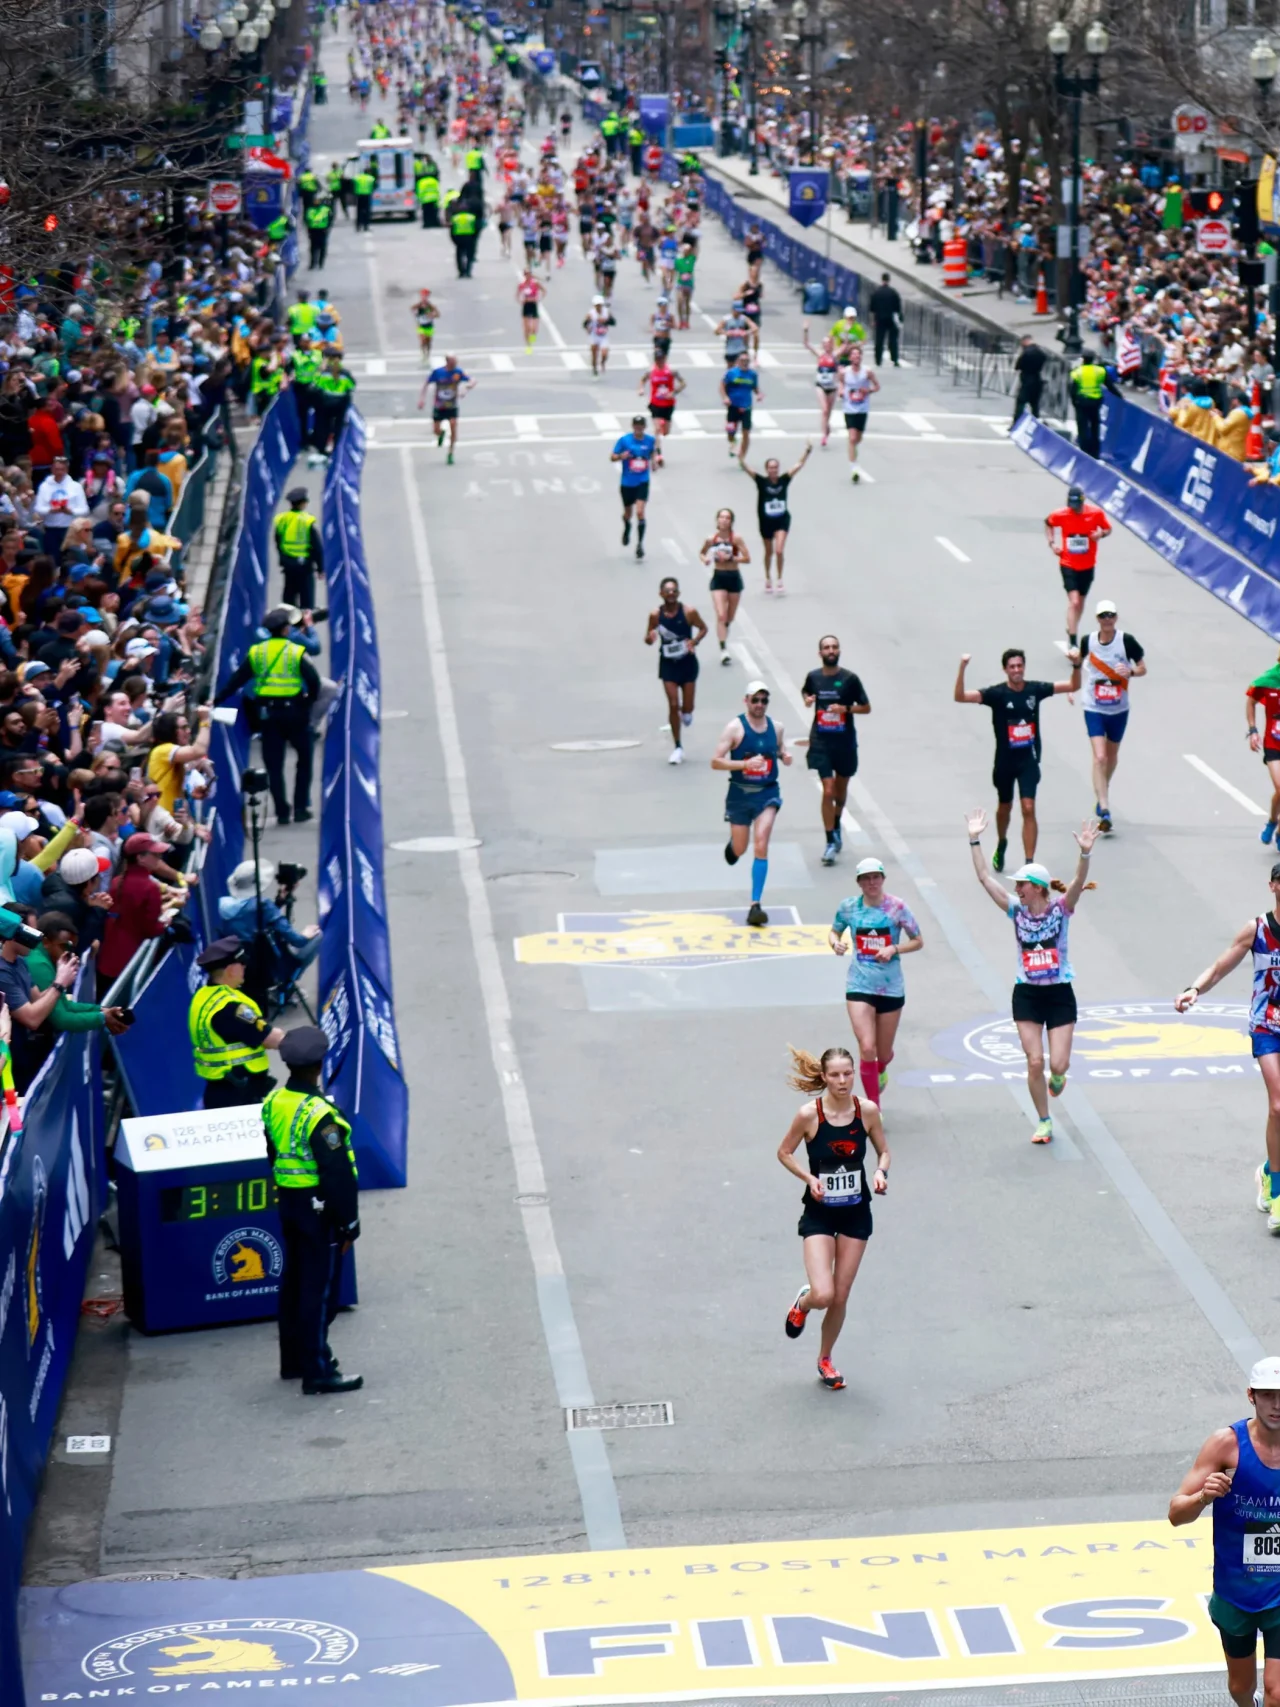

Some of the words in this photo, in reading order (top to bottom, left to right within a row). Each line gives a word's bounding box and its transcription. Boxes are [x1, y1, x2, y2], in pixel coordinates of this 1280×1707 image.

[930, 1069, 1072, 1083] BAN
[1089, 1068, 1151, 1078] OF
[178, 1129, 265, 1148] MARATHO
[827, 1174, 855, 1191] 9119
[188, 1179, 279, 1219] 3:10:
[218, 1231, 248, 1256] BOSTON
[251, 1231, 281, 1270] MARATHON
[205, 1292, 230, 1301] BANK
[232, 1289, 244, 1298] OF
[245, 1285, 279, 1295] AMERIC
[1233, 1493, 1267, 1507] TEAM
[1233, 1507, 1267, 1519] OUTRUN
[494, 1569, 652, 1589] 128TH
[684, 1552, 949, 1576] BOSTON
[92, 1651, 119, 1677] 128TH
[110, 1621, 228, 1651] BOSTON
[251, 1620, 347, 1662] MARATHON
[41, 1686, 137, 1701] BANK
[147, 1682, 191, 1695] OF
[200, 1672, 362, 1691] AMERICA
